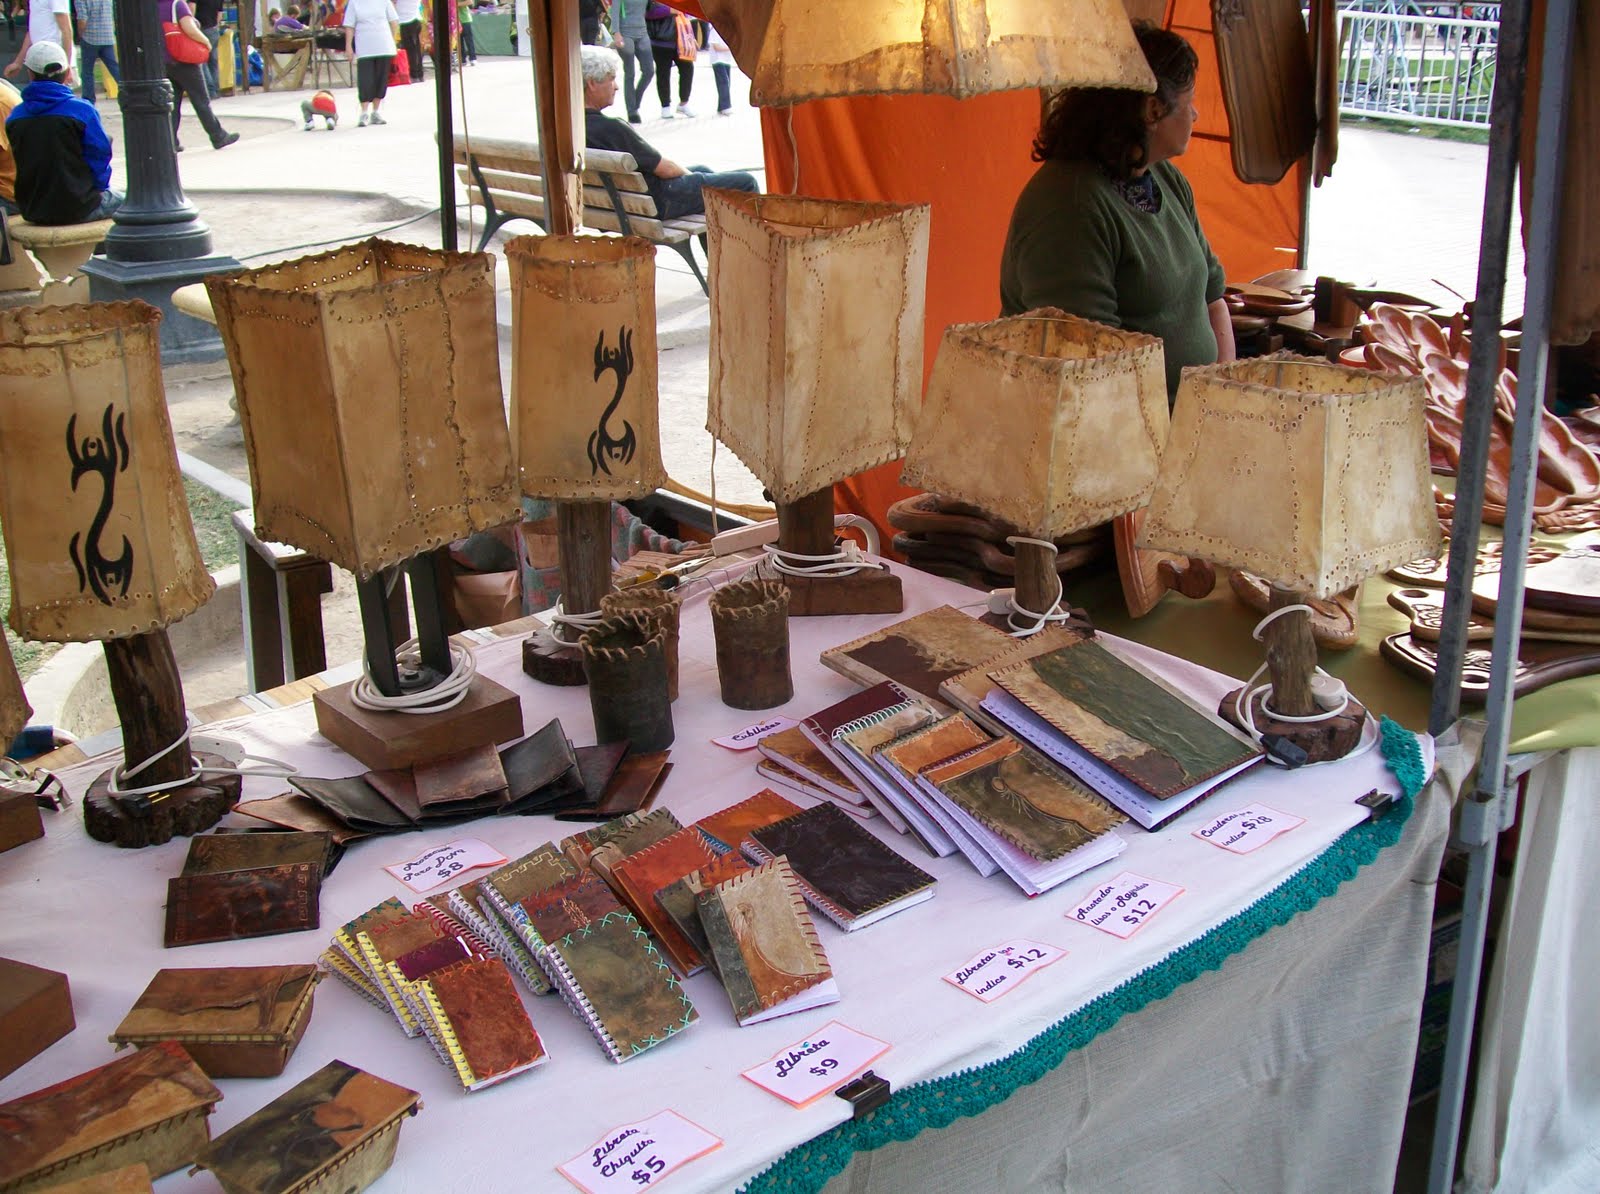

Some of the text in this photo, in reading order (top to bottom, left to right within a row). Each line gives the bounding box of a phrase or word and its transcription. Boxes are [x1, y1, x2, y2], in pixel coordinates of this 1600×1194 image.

[403, 866, 433, 881] Para
[437, 862, 463, 878] $8
[1077, 885, 1115, 920] Anotador
[1123, 899, 1157, 924] $12
[1007, 949, 1047, 969] $12
[775, 1039, 830, 1078] Libreta
[809, 1058, 839, 1076] $9
[592, 1128, 640, 1167] Libreta
[600, 1138, 656, 1177] Chiquita
[631, 1155, 666, 1185] $5
